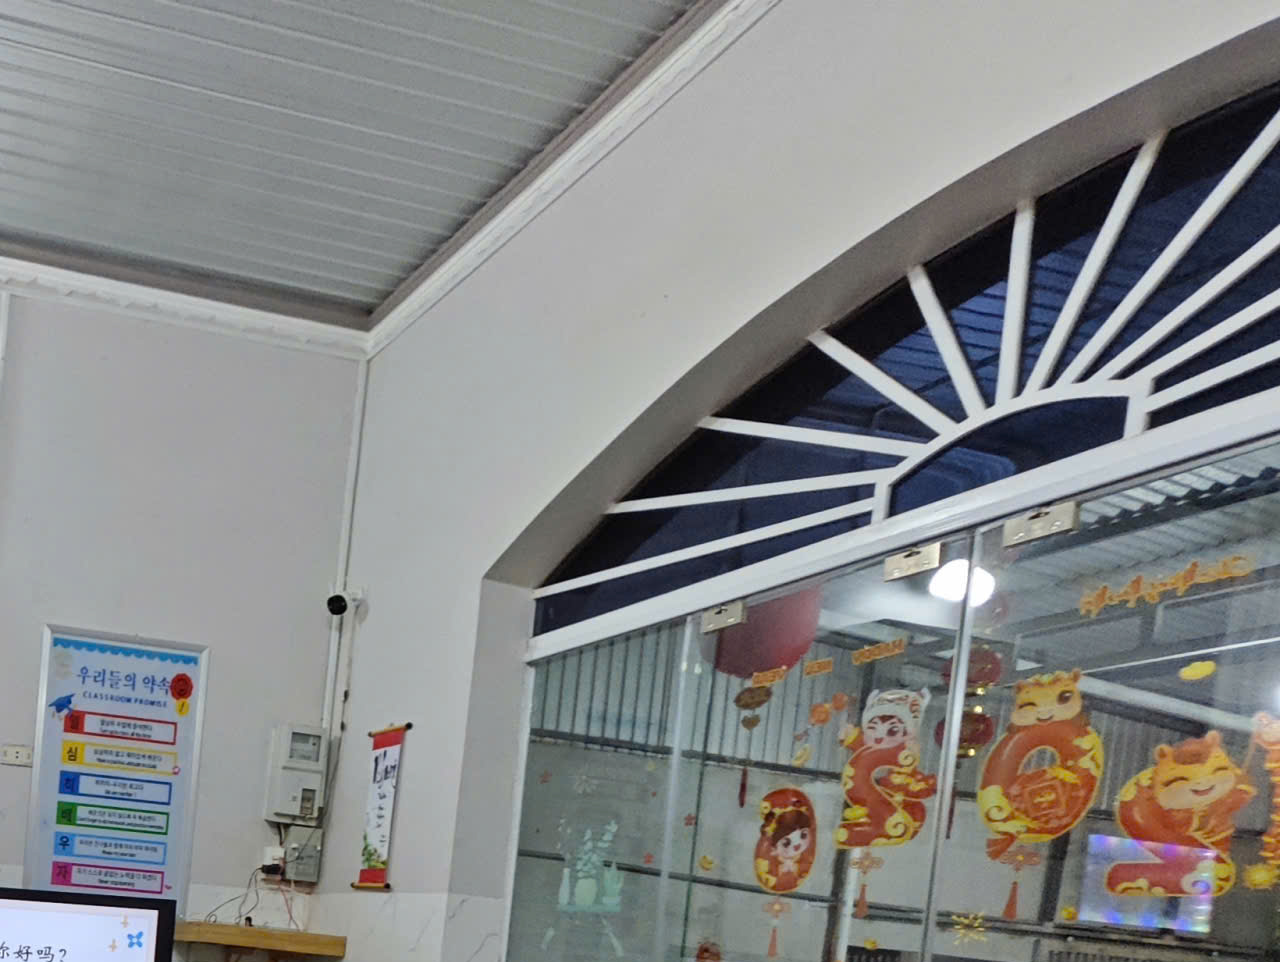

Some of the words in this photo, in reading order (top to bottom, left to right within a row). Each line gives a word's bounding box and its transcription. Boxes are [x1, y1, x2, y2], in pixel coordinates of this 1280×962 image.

[76, 666, 136, 692] 우리들의
[142, 675, 172, 696] 약속
[58, 835, 70, 851] 우
